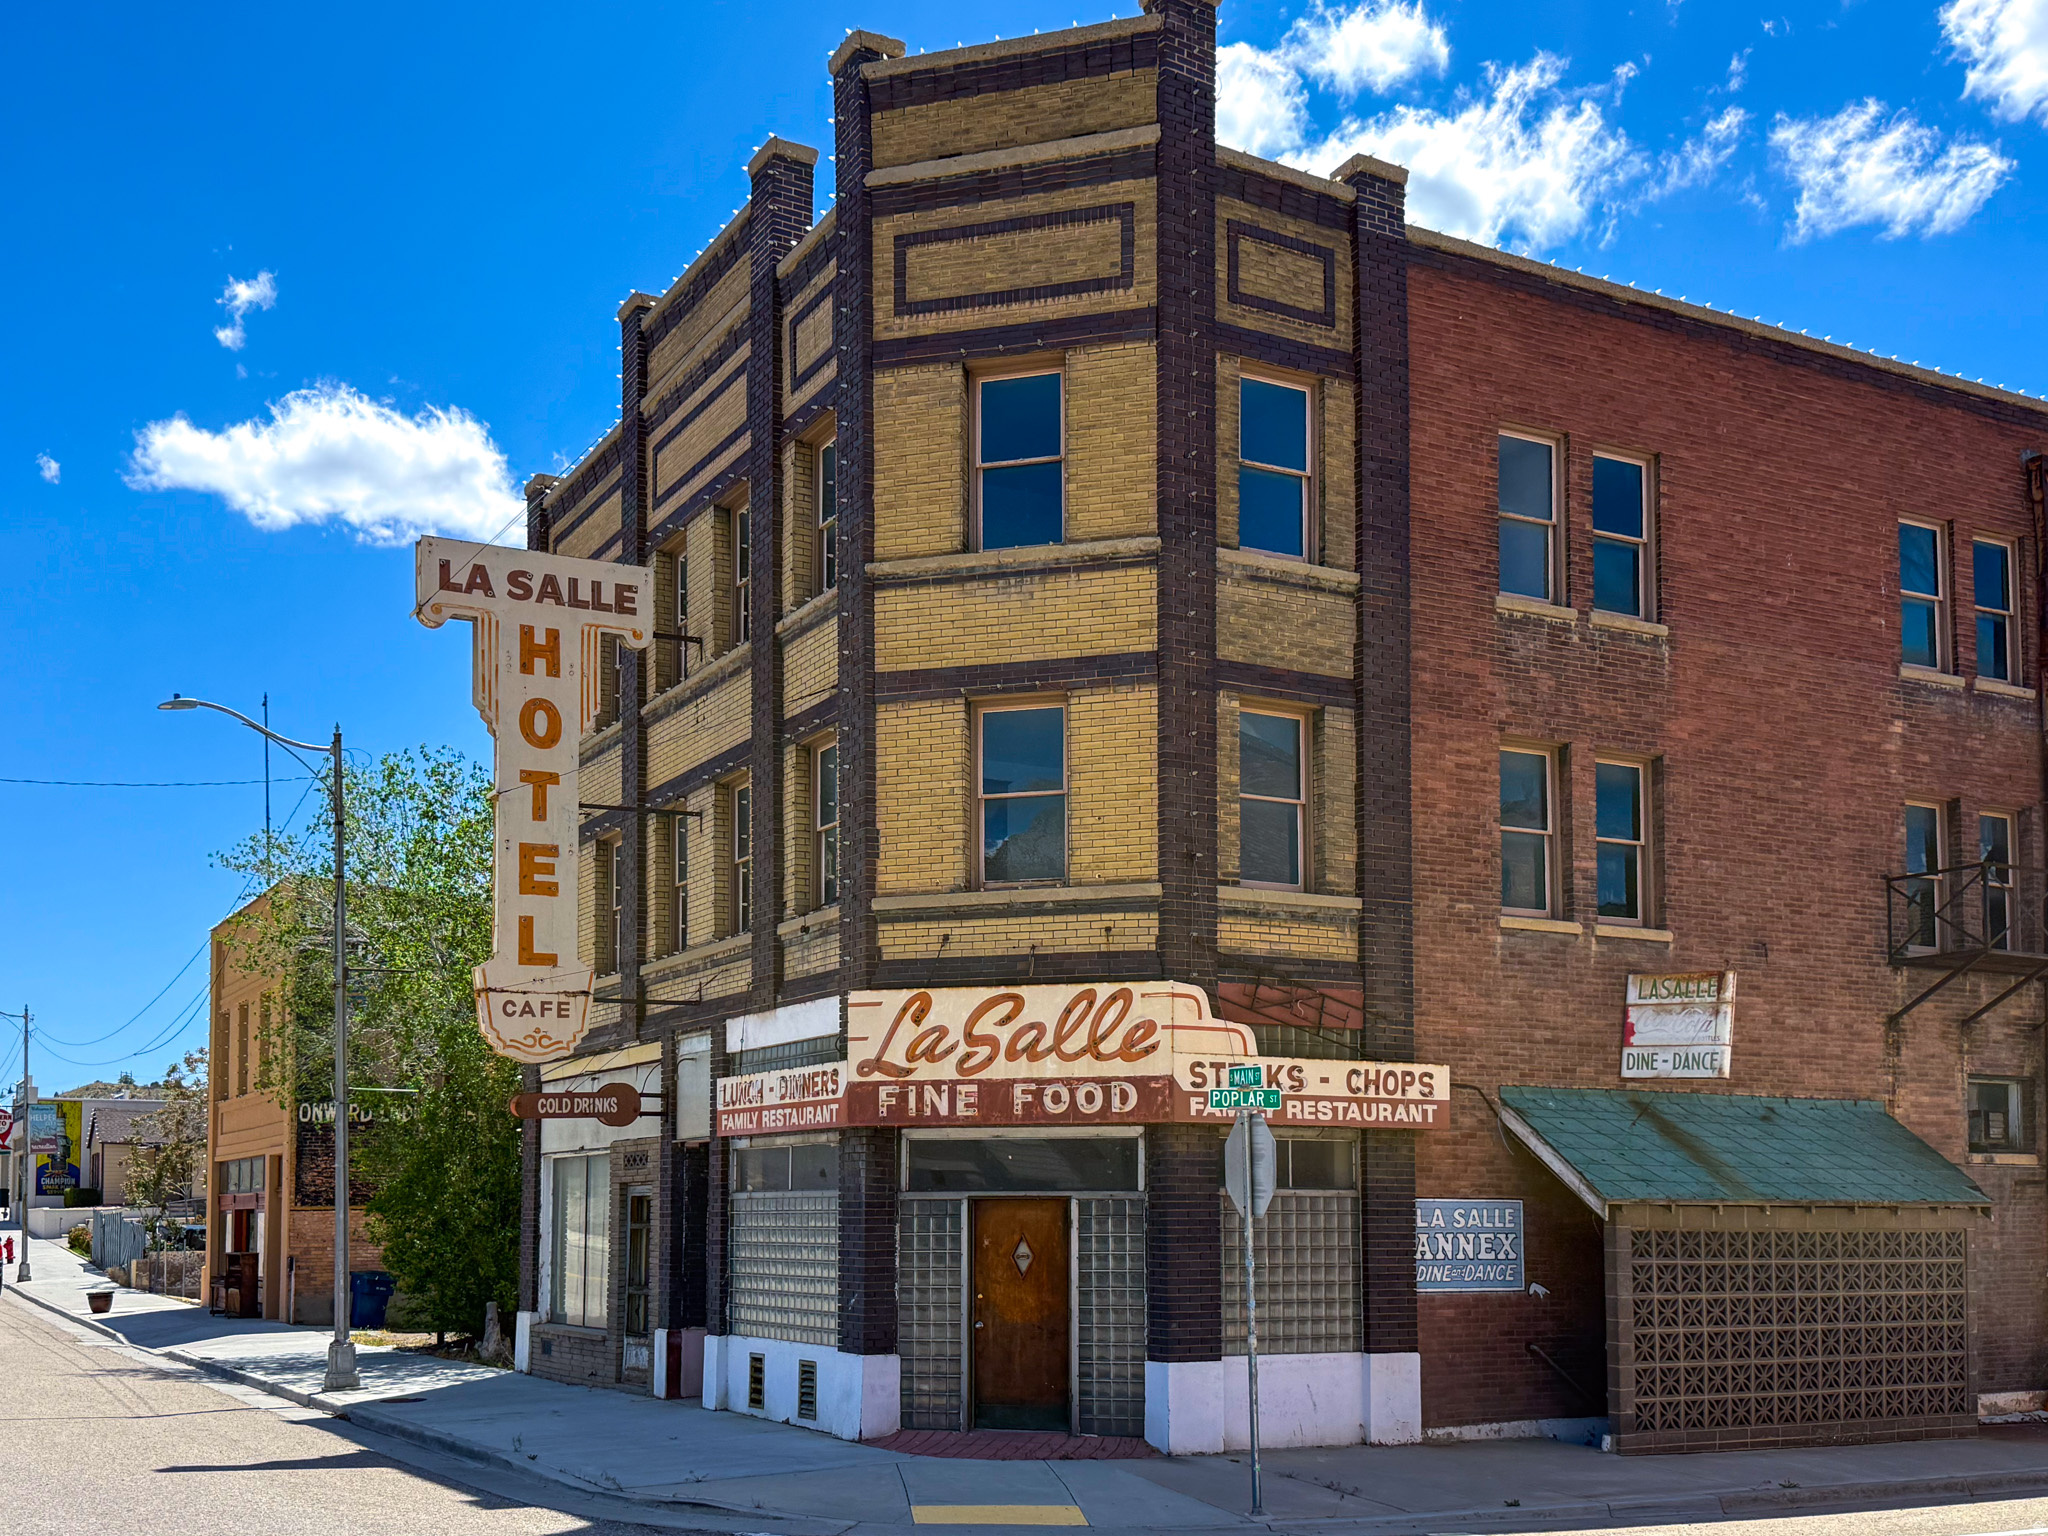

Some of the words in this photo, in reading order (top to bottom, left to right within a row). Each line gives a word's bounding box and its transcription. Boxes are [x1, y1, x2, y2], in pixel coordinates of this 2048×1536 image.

[438, 558, 497, 599] LA
[506, 568, 638, 617] SALLE
[517, 623, 563, 967] HOTEL
[1637, 976, 1718, 1000] LASALLE
[501, 999, 571, 1019] CAFE
[1626, 1052, 1659, 1071] DINE
[1672, 1051, 1719, 1071] DANCE
[721, 1078, 764, 1108] LUNCH
[777, 1067, 840, 1102] DINNERS
[1189, 1060, 1305, 1093] STKS
[1346, 1067, 1435, 1098] CHOPS
[1234, 1069, 1254, 1085] MAIN
[1254, 1071, 1260, 1080] ST
[537, 1098, 572, 1114] COLD
[573, 1097, 618, 1114] DRINKS
[878, 1083, 979, 1118] FINE
[1012, 1081, 1139, 1115] FOOD
[1212, 1090, 1265, 1107] POPLAR
[1269, 1094, 1278, 1103] ST
[299, 1102, 373, 1122] ONWRD
[721, 1111, 759, 1131] FAMILY
[762, 1103, 839, 1128] RESTAURANT
[1286, 1100, 1438, 1123] RESTAURANT
[41, 1177, 76, 1185] CHAMPION
[1416, 1208, 1446, 1228] LA
[1452, 1208, 1515, 1229] SALLE
[1416, 1232, 1518, 1261] ANNEX
[1416, 1264, 1452, 1282] DINE
[1464, 1264, 1518, 1282] DANCE
